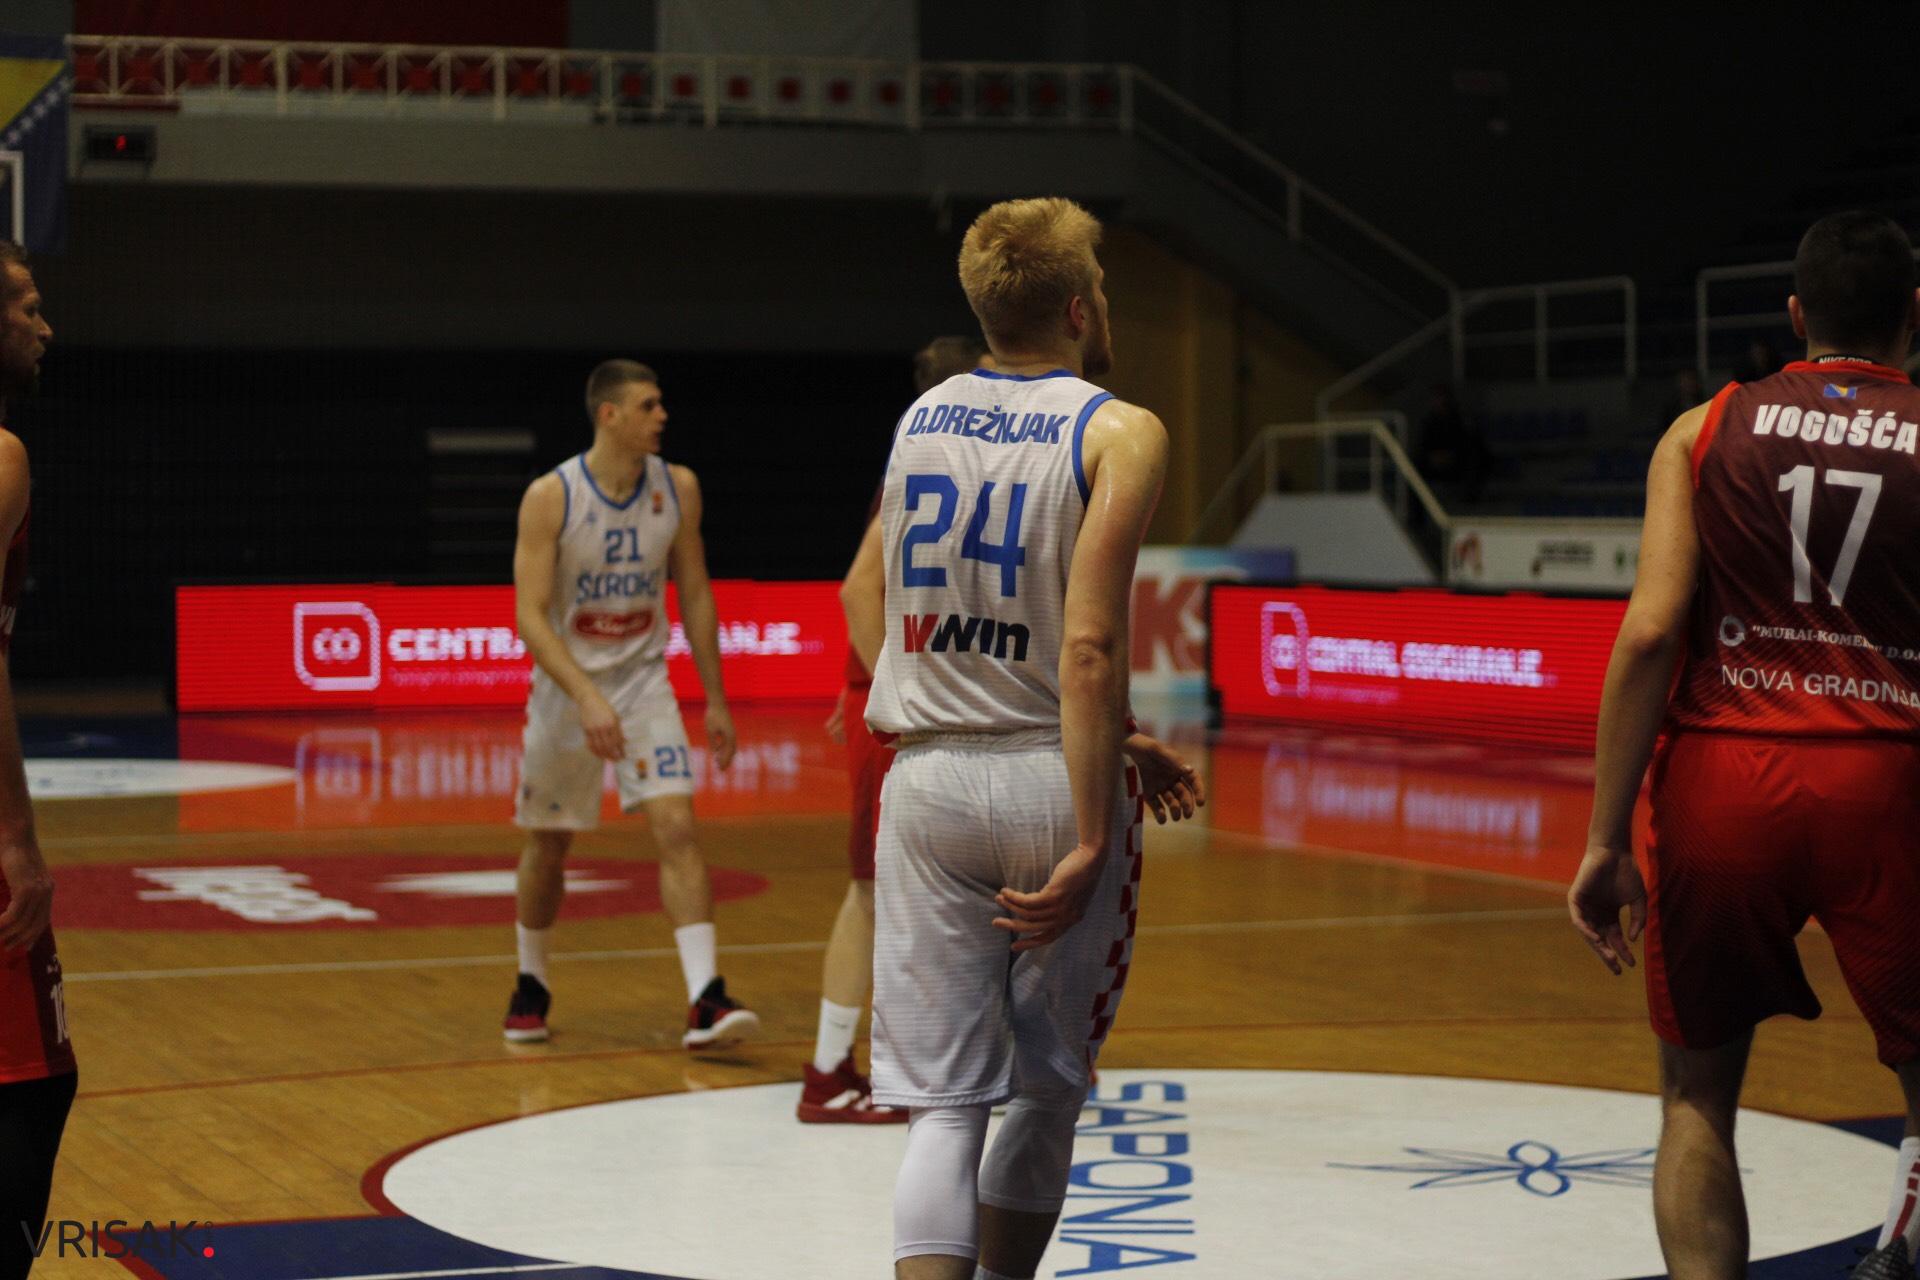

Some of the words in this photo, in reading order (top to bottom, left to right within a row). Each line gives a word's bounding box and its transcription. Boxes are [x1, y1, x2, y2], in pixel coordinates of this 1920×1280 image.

[906, 404, 1070, 445] D.DREŽNJAK
[1752, 404, 1918, 455] VOGOŠĆA
[604, 527, 644, 565] 21
[902, 474, 1028, 598] 24
[1777, 464, 1883, 608] 17
[1722, 664, 1795, 691] NOVA
[655, 746, 693, 778] 21
